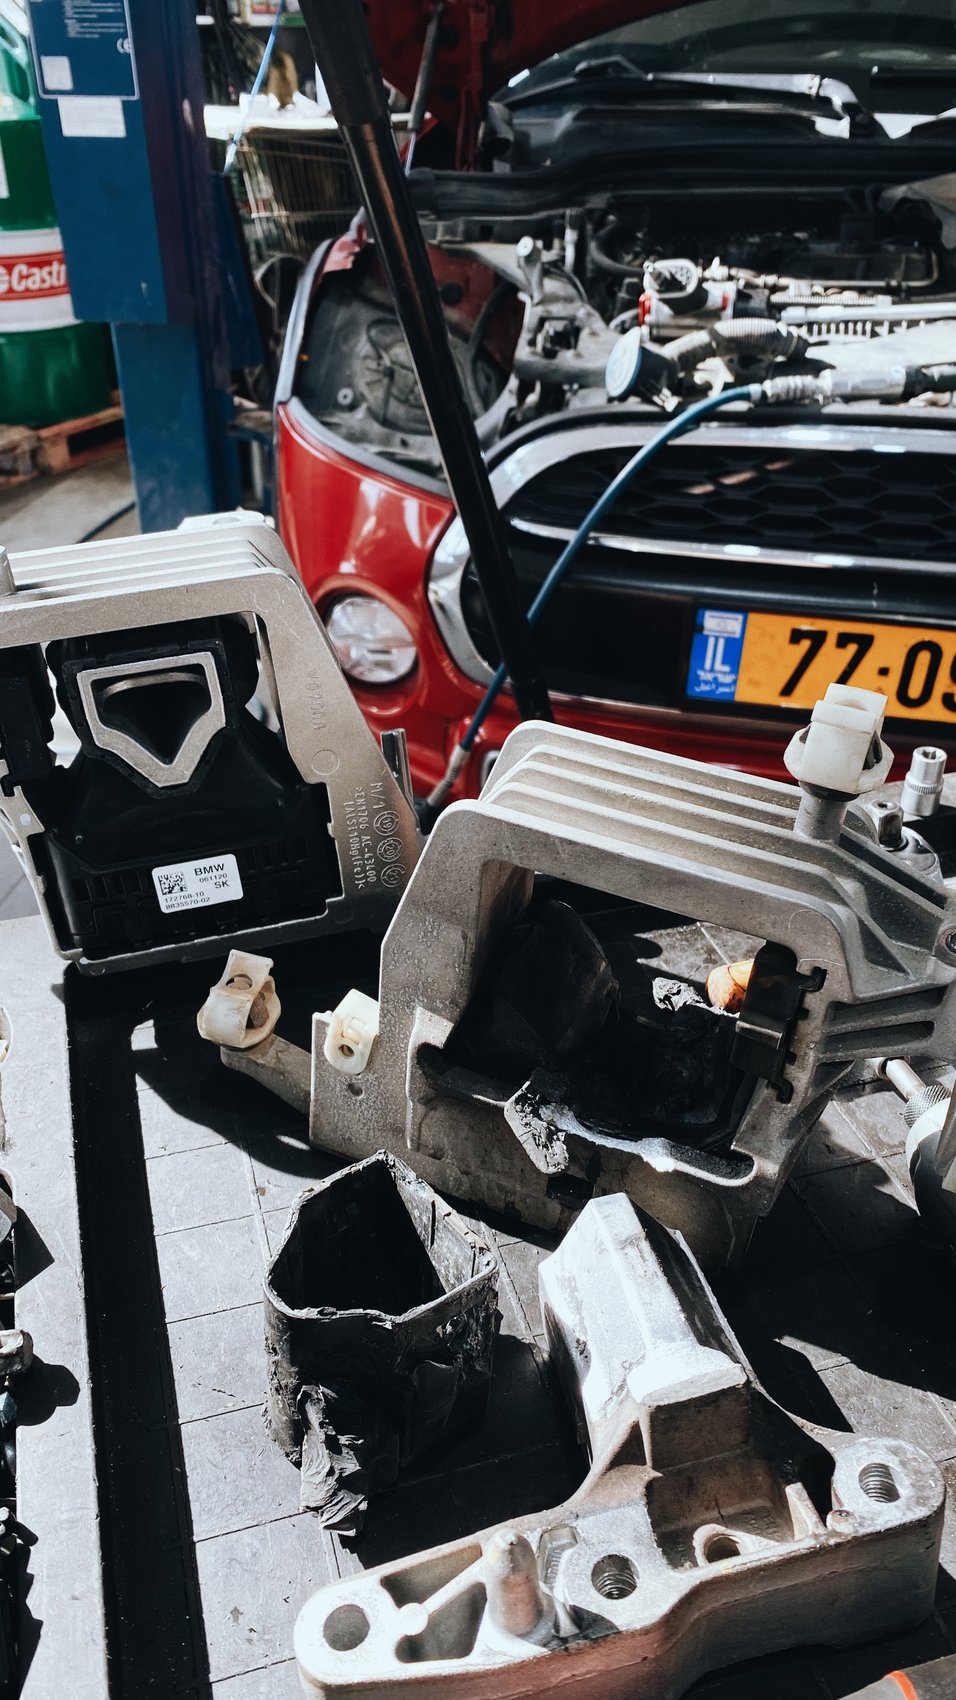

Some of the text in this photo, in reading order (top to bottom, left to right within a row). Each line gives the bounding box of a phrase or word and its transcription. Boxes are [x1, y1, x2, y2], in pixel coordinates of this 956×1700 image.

[704, 635, 731, 672] IL
[194, 863, 225, 876] BMW
[199, 873, 228, 883] 061120
[214, 880, 229, 889] SK
[164, 891, 205, 904] 172768-10
[165, 897, 210, 910] 8835570-02
